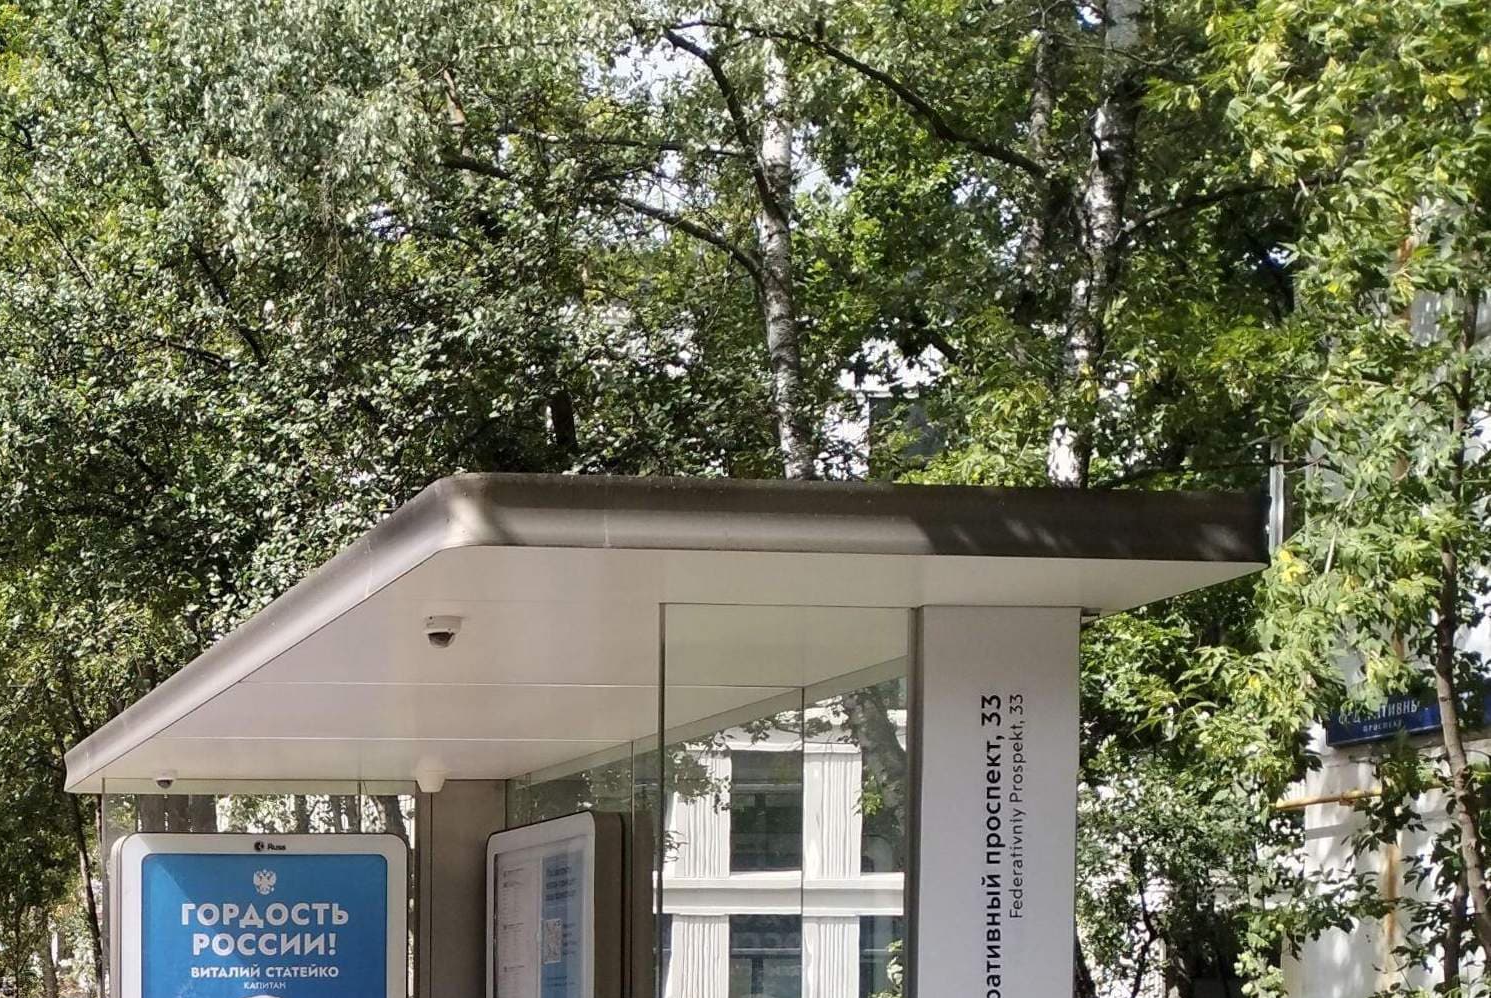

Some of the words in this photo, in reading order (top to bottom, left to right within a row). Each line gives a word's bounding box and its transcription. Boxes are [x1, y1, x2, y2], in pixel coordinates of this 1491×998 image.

[980, 694, 1002, 727] 33
[1009, 693, 1024, 716] 33
[1008, 720, 1027, 803] Prospekt,
[985, 735, 1006, 864] проспект,
[1008, 807, 1027, 919] Federativniy
[180, 902, 350, 929] ГОРДОСТЬ
[192, 932, 338, 957] РОССИИ!
[190, 964, 261, 979] ВИТАЛИЙ
[265, 963, 340, 978] СТАТЕЙКО
[243, 981, 287, 990] КАПИТАН
